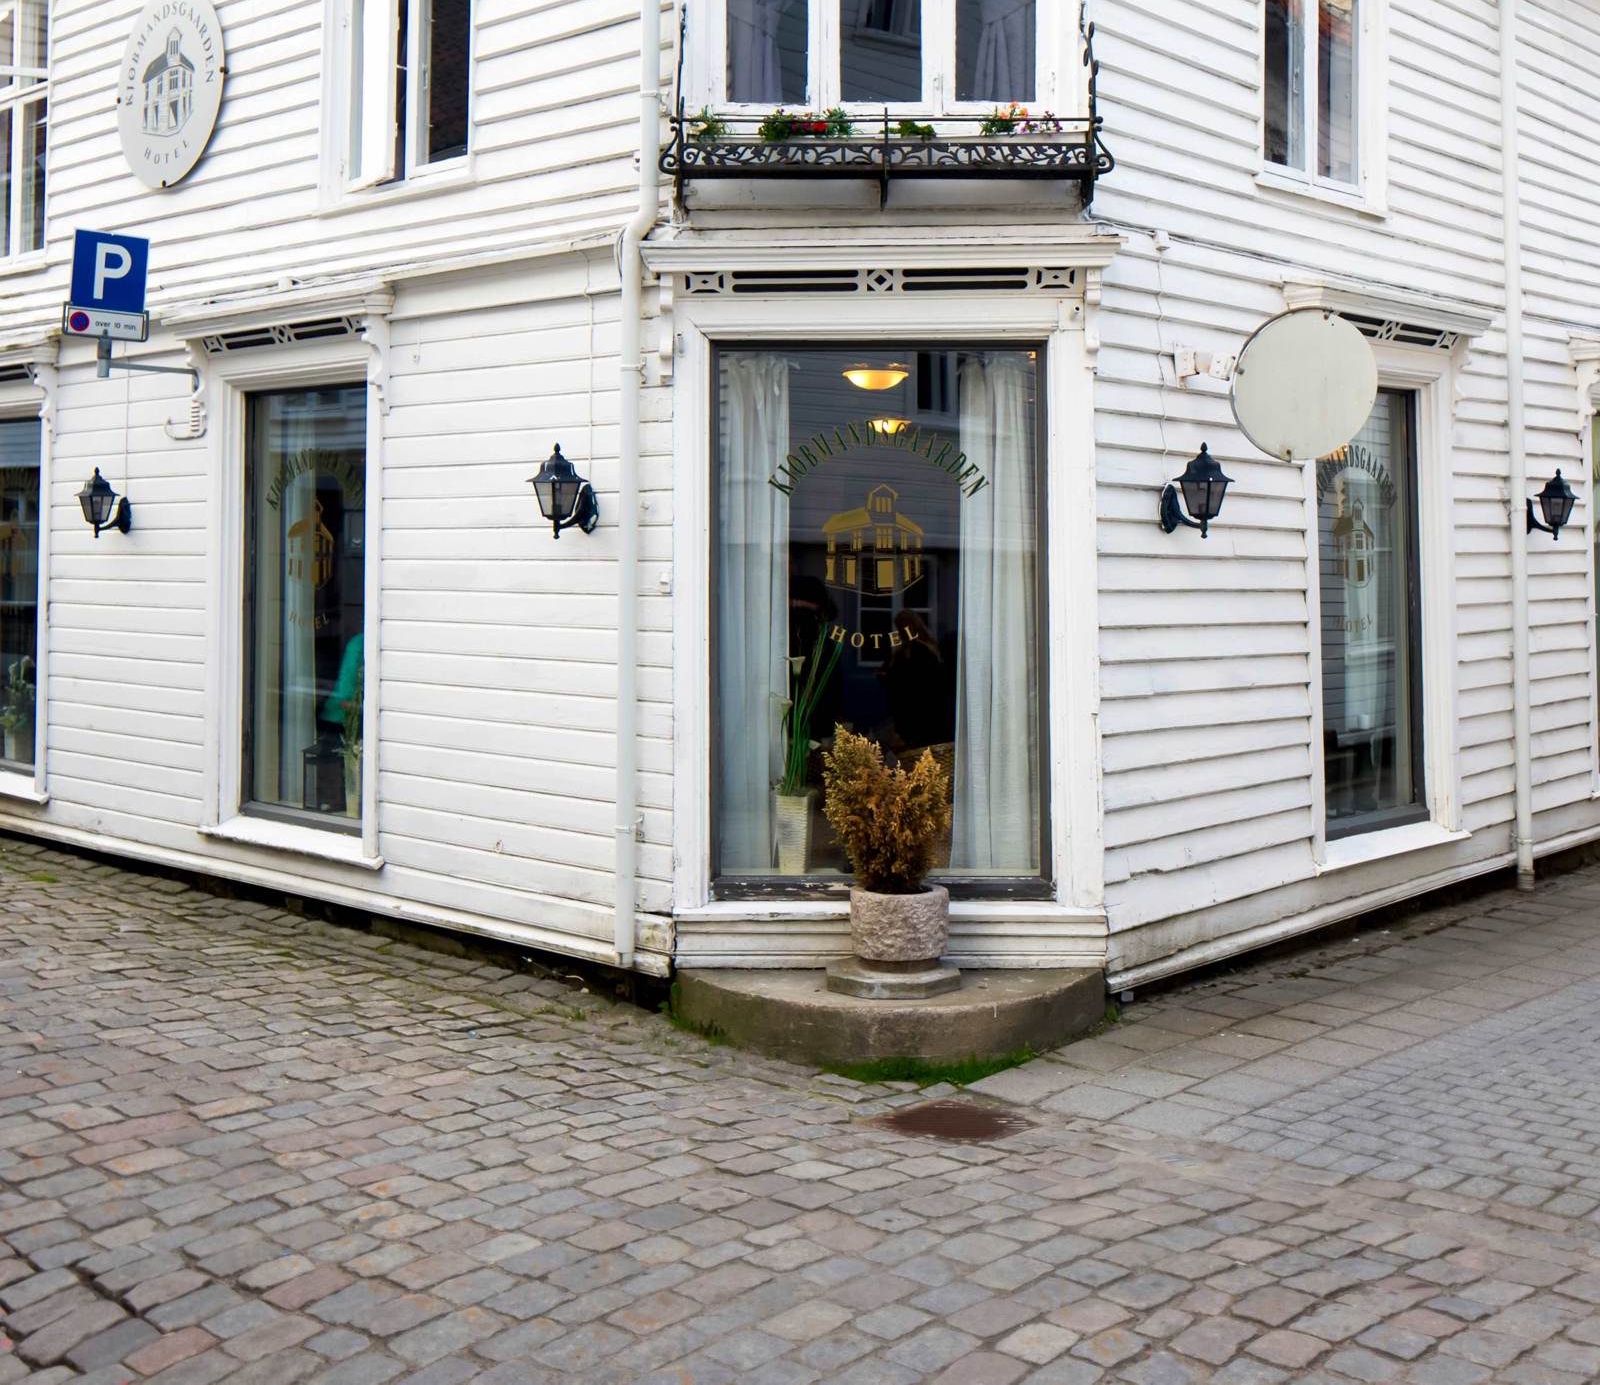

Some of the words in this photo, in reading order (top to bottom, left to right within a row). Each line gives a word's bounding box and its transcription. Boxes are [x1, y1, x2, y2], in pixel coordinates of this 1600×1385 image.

[144, 140, 189, 165] HOTEL
[93, 242, 132, 300] P
[95, 320, 111, 328] over
[289, 608, 329, 630] HOEL
[830, 625, 919, 648] HOTEL
